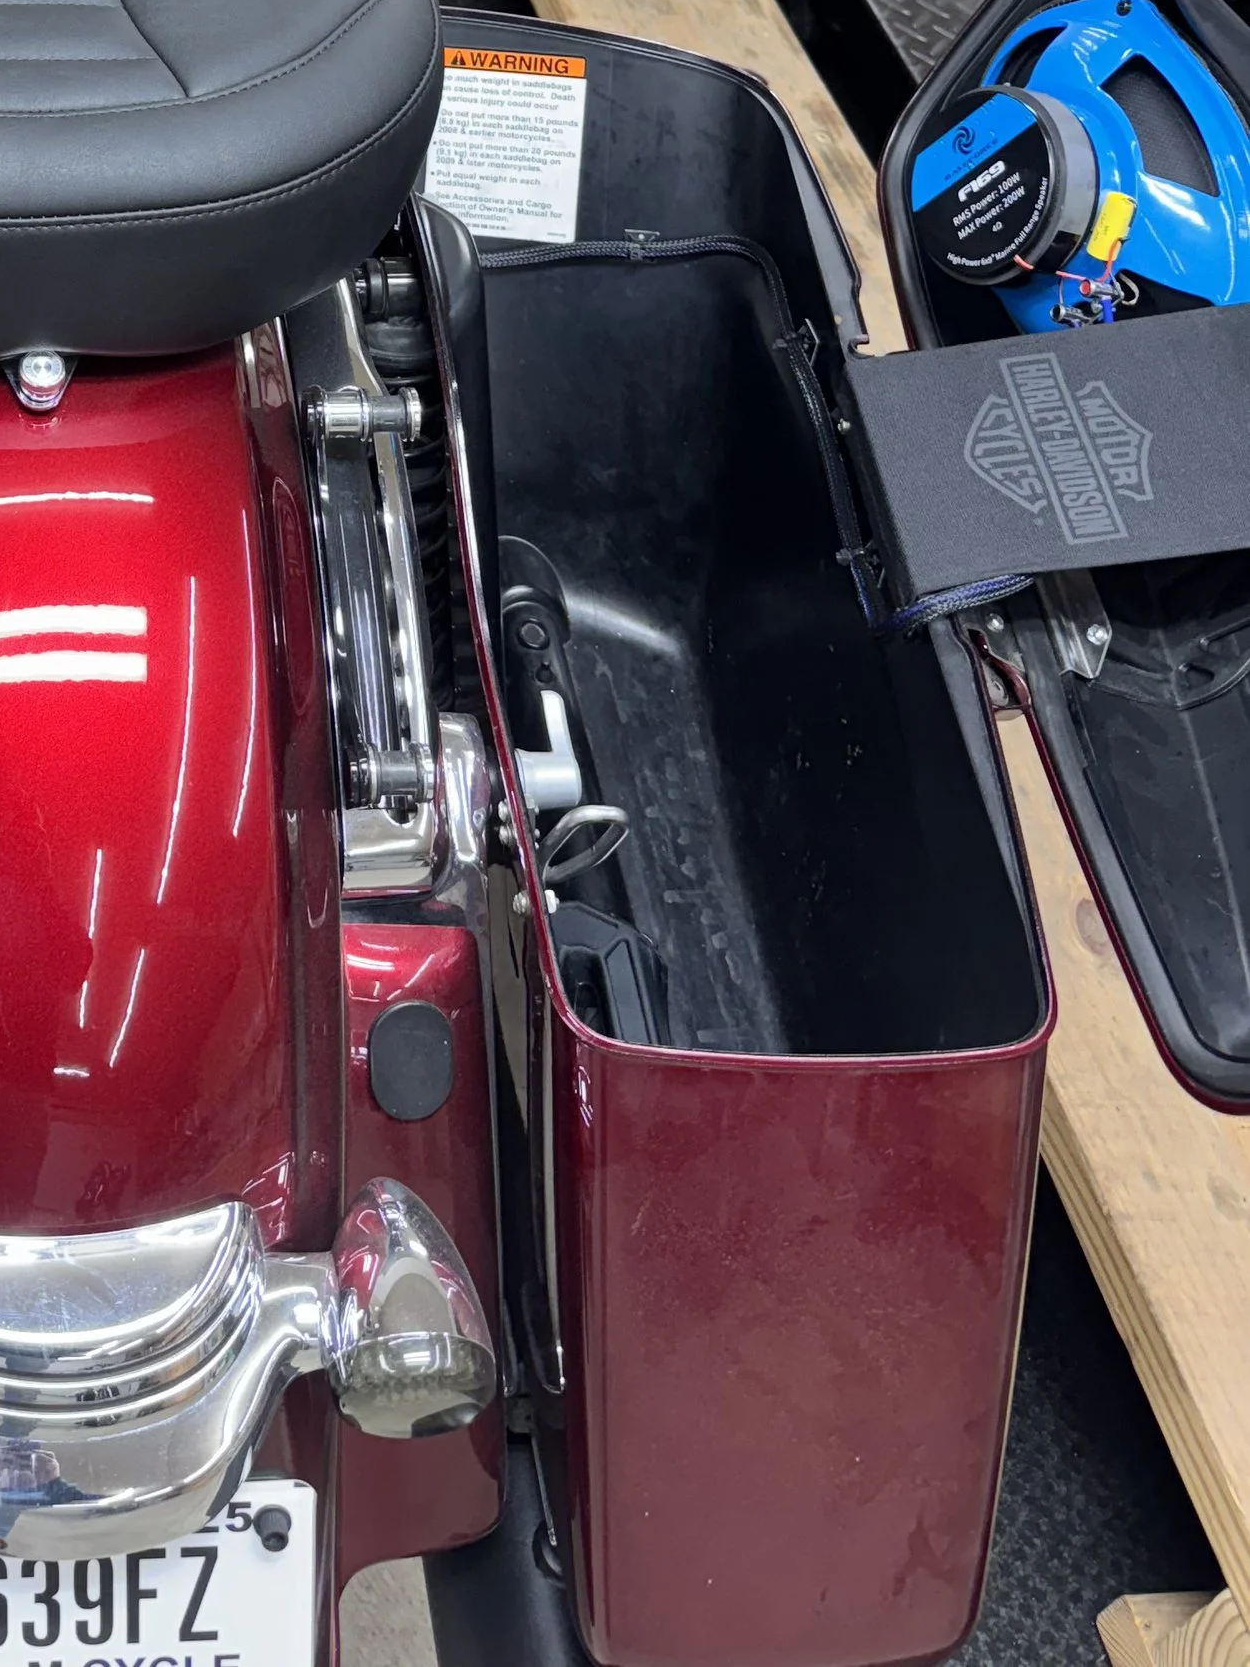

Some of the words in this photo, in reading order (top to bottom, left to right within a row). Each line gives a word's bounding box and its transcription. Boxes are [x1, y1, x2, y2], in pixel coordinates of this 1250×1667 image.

[470, 51, 569, 74] WARNING
[947, 252, 961, 265] High
[960, 256, 980, 267] Power
[995, 240, 1017, 261] Marine
[1014, 230, 1027, 246] Full
[1025, 209, 1039, 234] Range
[1034, 177, 1048, 210] Speaker
[952, 208, 971, 227] RMS
[999, 172, 1021, 194] 100W
[957, 222, 976, 240] MAX
[1003, 186, 1026, 208] 200W
[974, 407, 1044, 496] CYCLES
[1011, 363, 1115, 535] HARLEY-DAVIDSON
[1079, 397, 1141, 491] MOTOR
